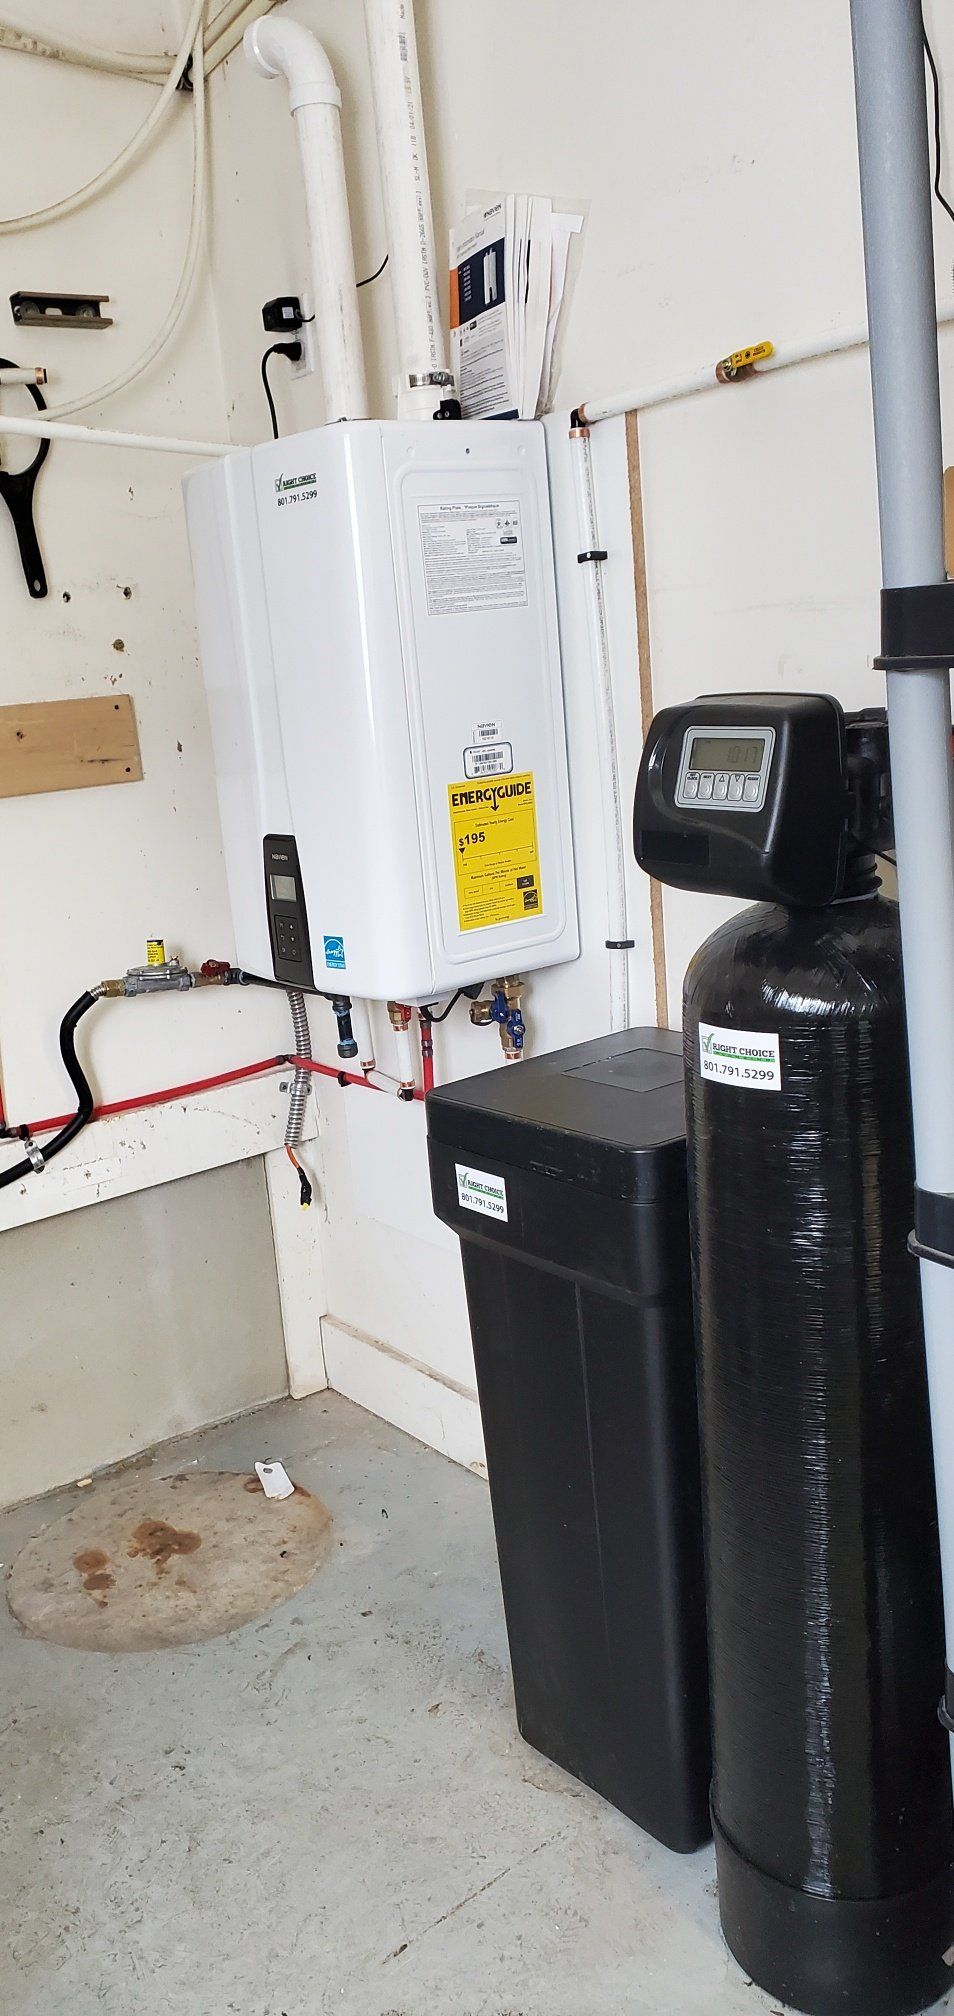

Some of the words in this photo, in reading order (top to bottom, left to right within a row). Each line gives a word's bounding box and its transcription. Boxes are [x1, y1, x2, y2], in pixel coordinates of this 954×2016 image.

[283, 478, 297, 486] RIGHT
[298, 473, 316, 482] CHOICE
[277, 490, 318, 507] 801.791.5299
[452, 781, 532, 811] ENERGYGUIDE
[458, 831, 486, 847] $195
[712, 1042, 738, 1054] RIGHT
[738, 1047, 776, 1058] CHOICE
[703, 1060, 775, 1081] 801.791.5299
[468, 1180, 483, 1189] RIGHT
[484, 1185, 503, 1196] CHOICE
[461, 1192, 505, 1214] 801.791.5299
